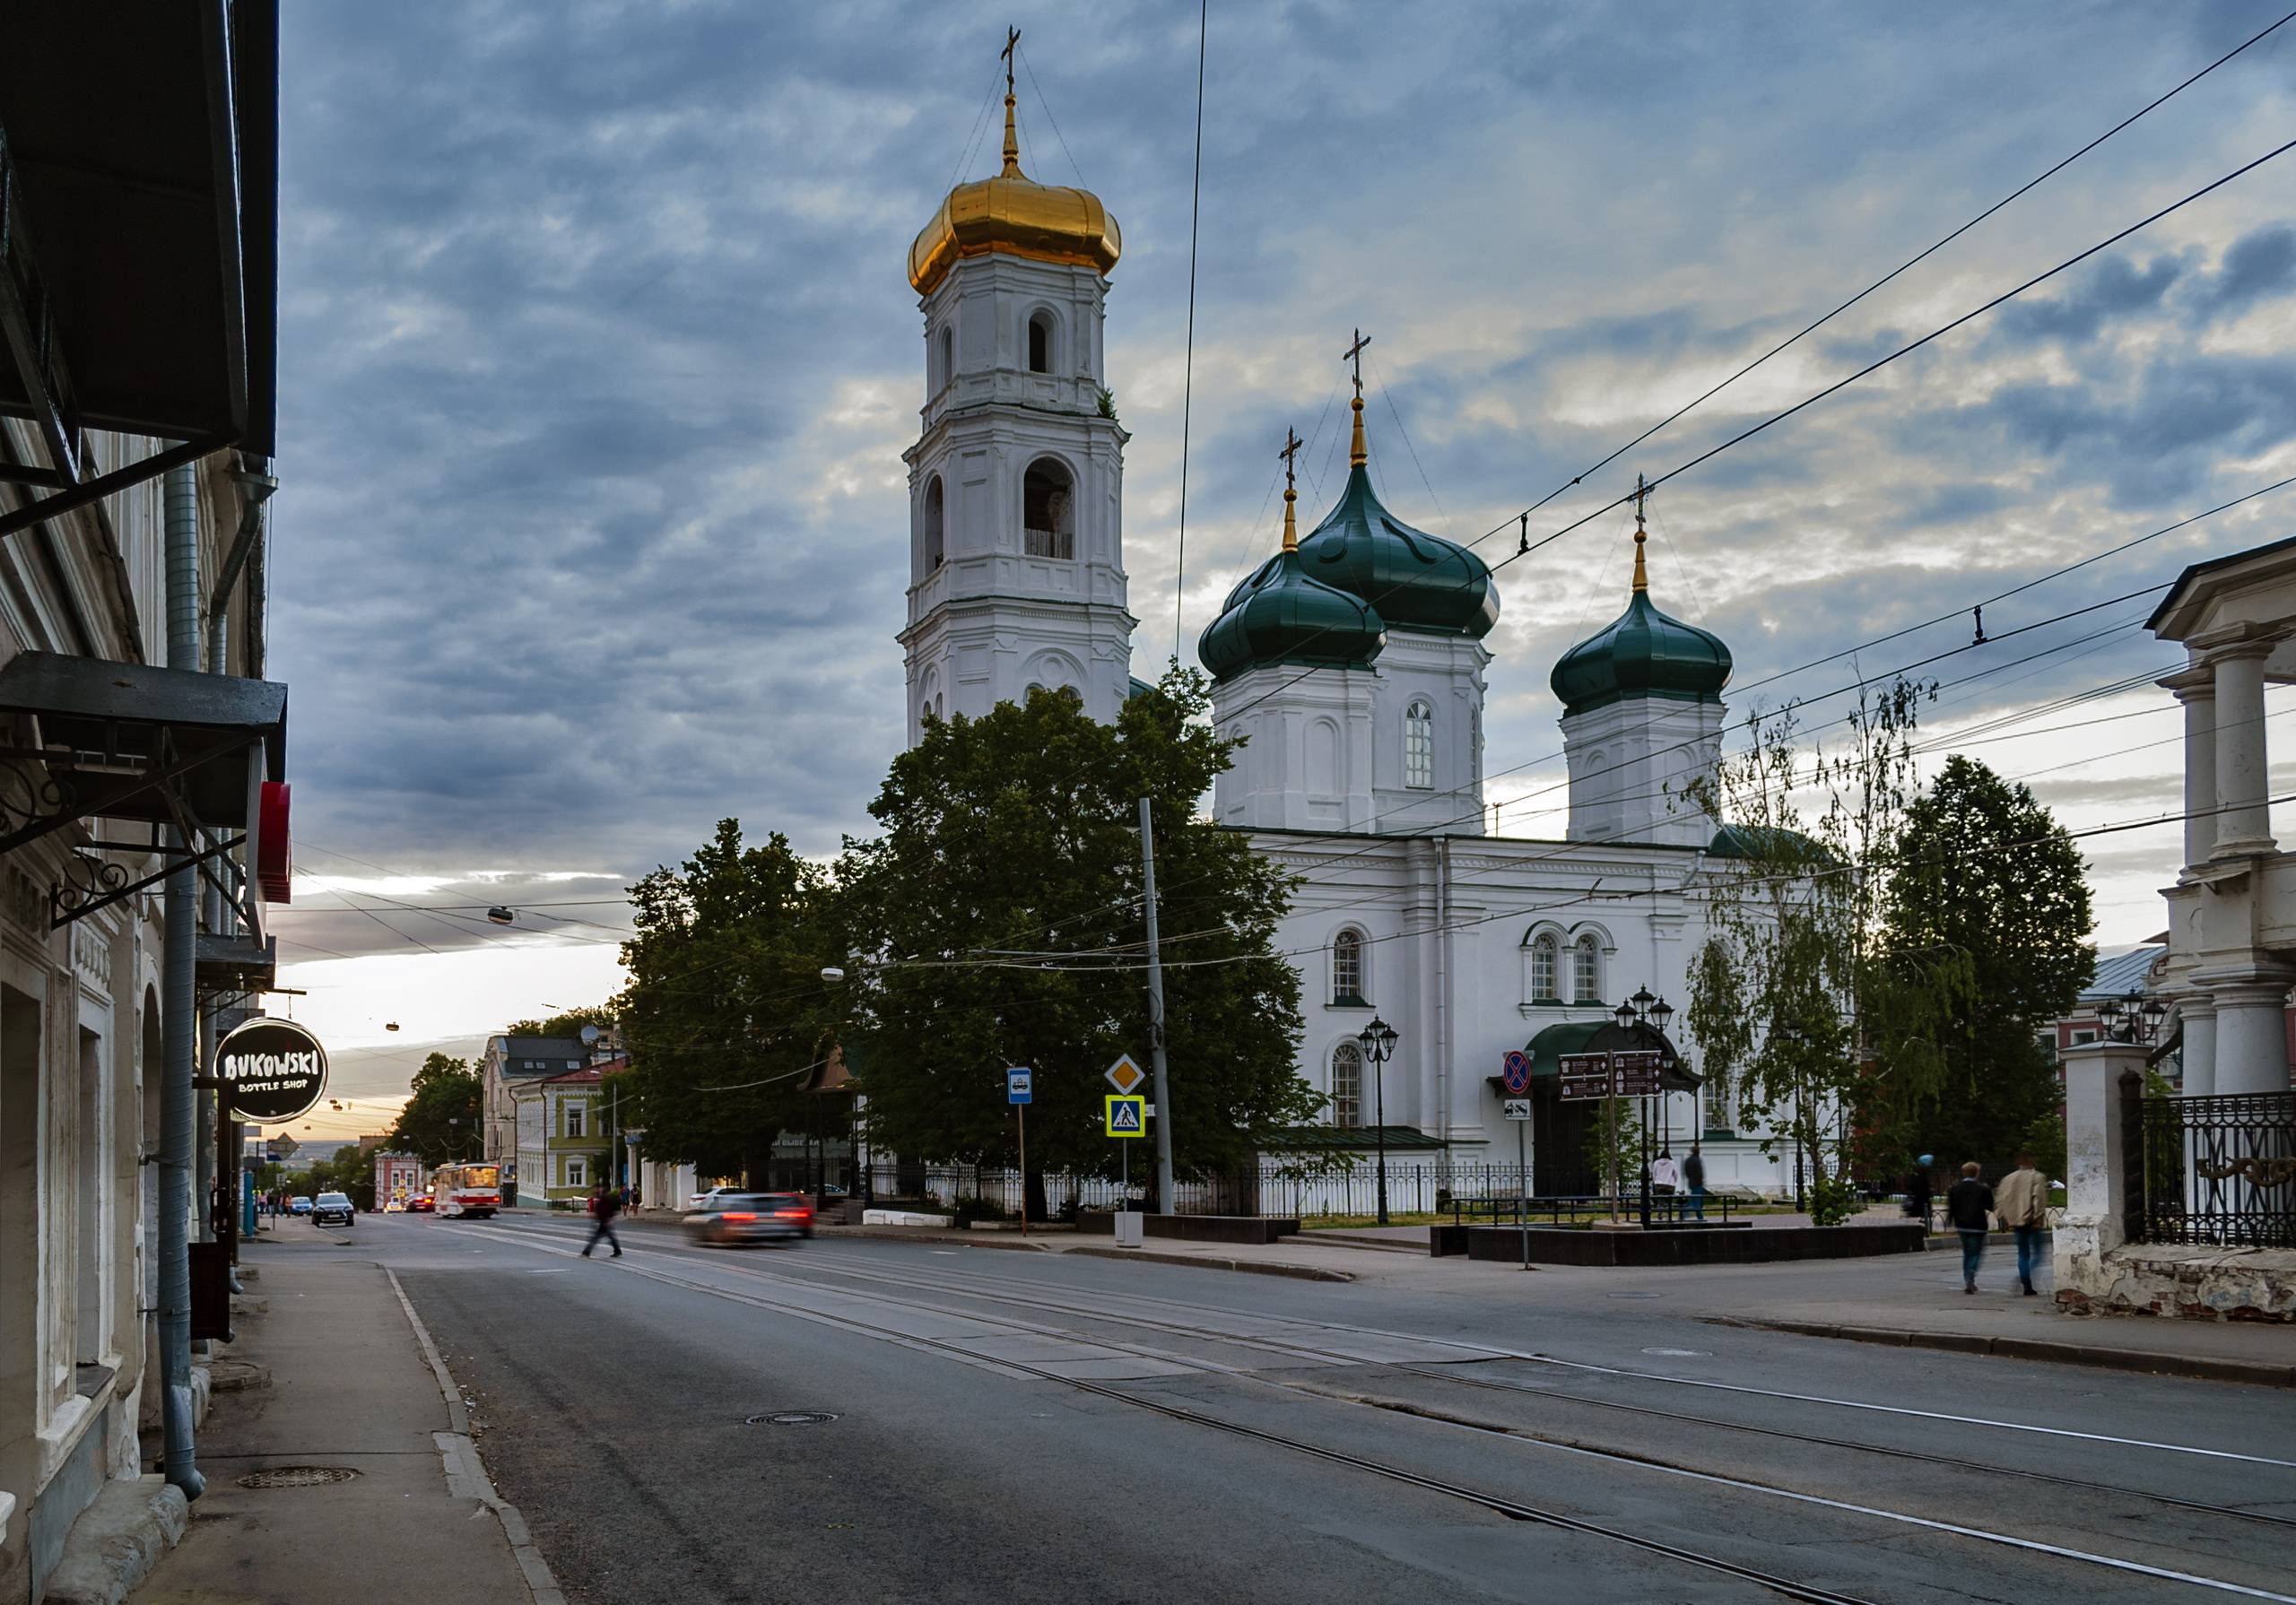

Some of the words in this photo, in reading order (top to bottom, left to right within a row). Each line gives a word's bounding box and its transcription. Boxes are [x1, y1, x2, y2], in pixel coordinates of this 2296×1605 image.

[224, 1050, 318, 1080] BUKOWSKI
[239, 1081, 279, 1092] BOTTLE
[283, 1079, 308, 1089] SHOP
